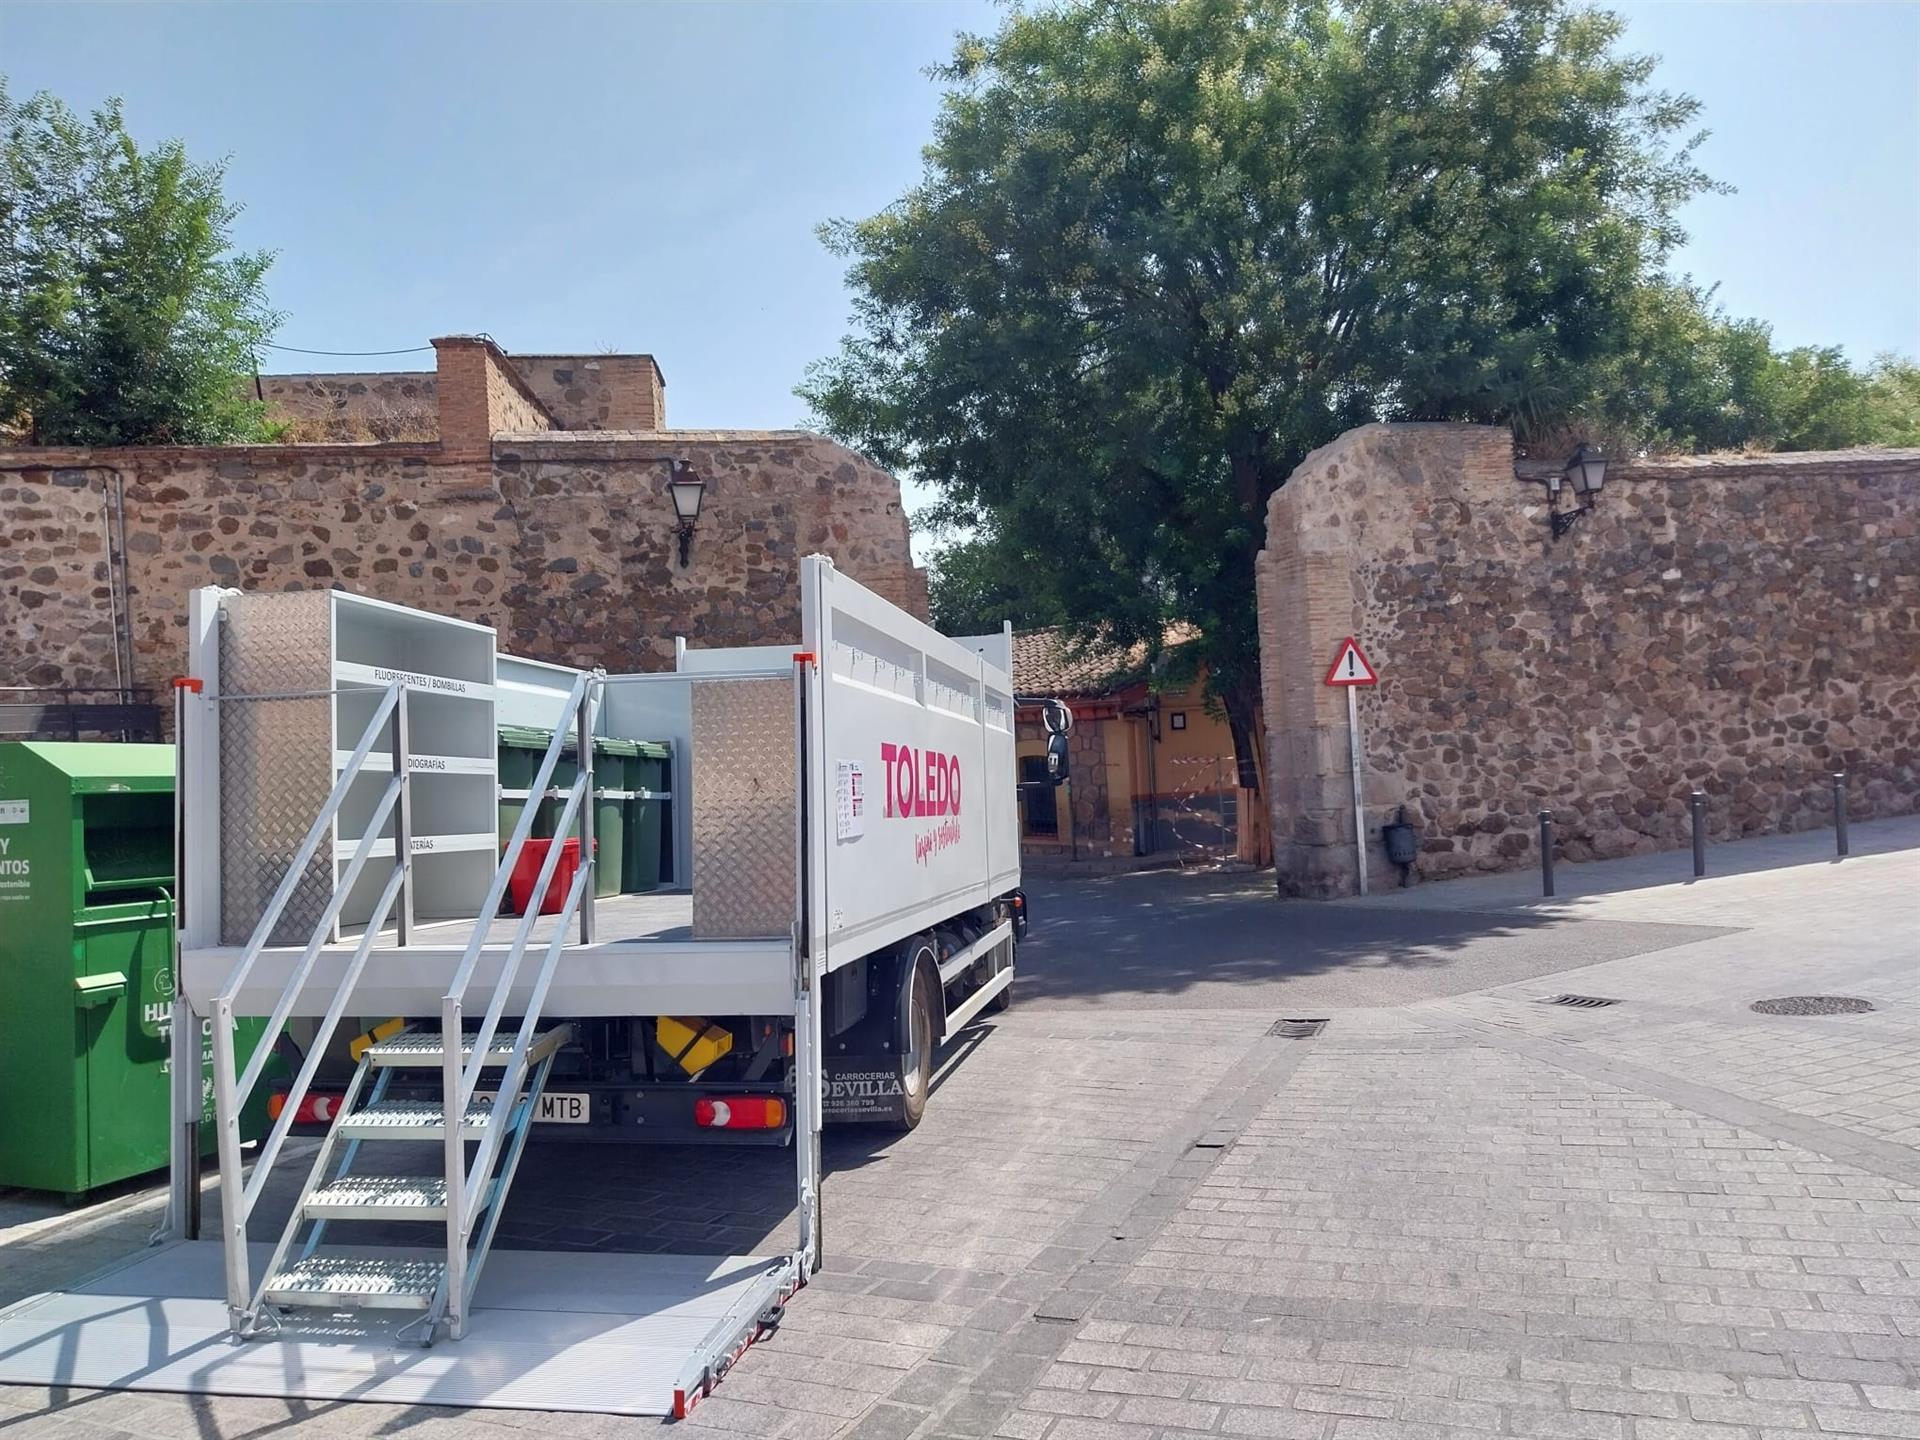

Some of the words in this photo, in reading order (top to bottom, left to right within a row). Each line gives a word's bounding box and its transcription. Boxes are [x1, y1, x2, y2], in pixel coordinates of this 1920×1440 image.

[432, 678, 466, 693] BOMBILLAS
[408, 758, 446, 770] DIOGRAFÍAS
[881, 742, 961, 818] TOLEDO
[410, 837, 434, 850] TERÍAS
[835, 1071, 896, 1081] CARROCERIAS
[541, 1096, 582, 1119] MTB
